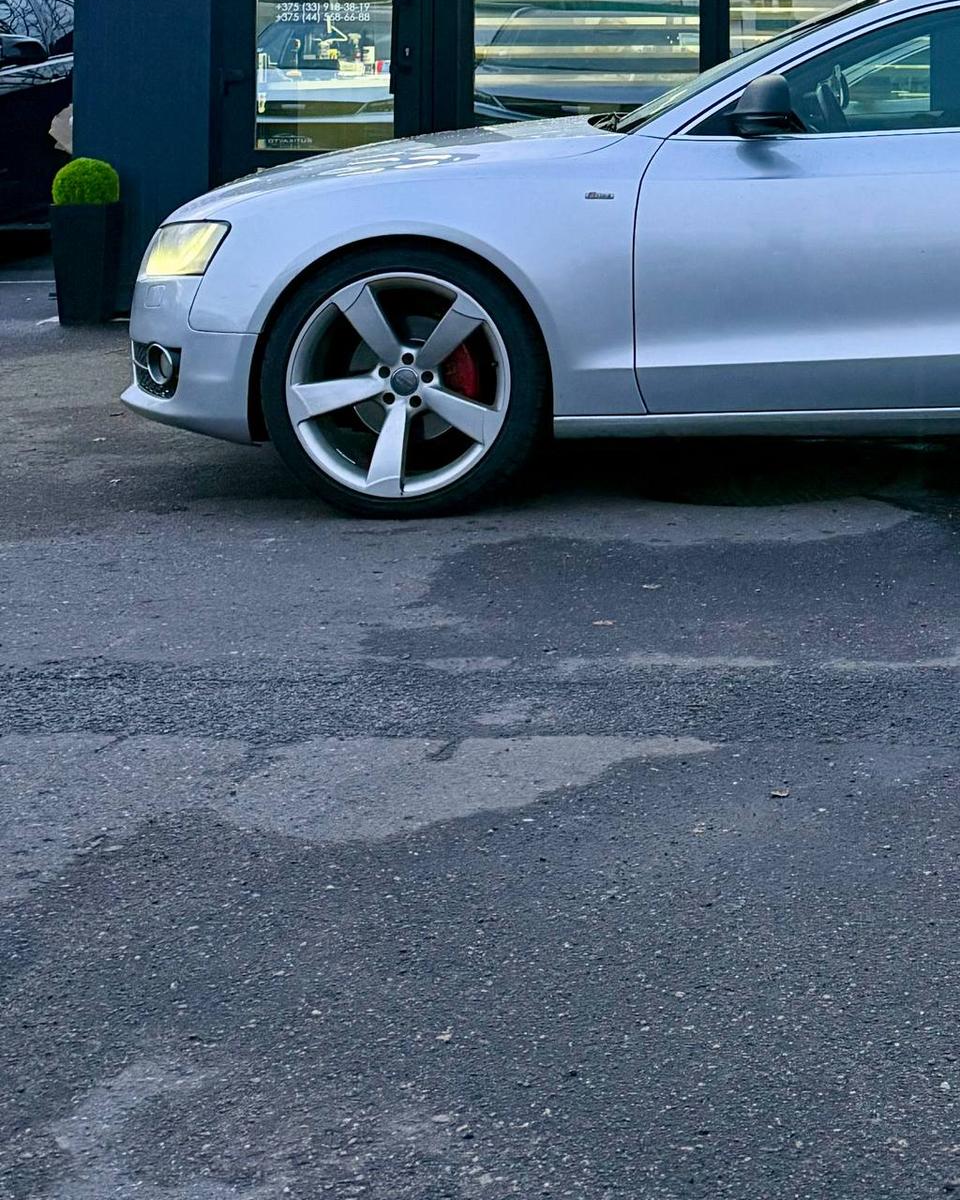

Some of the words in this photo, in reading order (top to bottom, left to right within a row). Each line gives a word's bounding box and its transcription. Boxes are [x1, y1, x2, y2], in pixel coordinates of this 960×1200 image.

[275, 2, 299, 12] +375
[302, 2, 321, 13] (33)
[323, 2, 371, 12] 918-38-19
[302, 12, 320, 23] (44)
